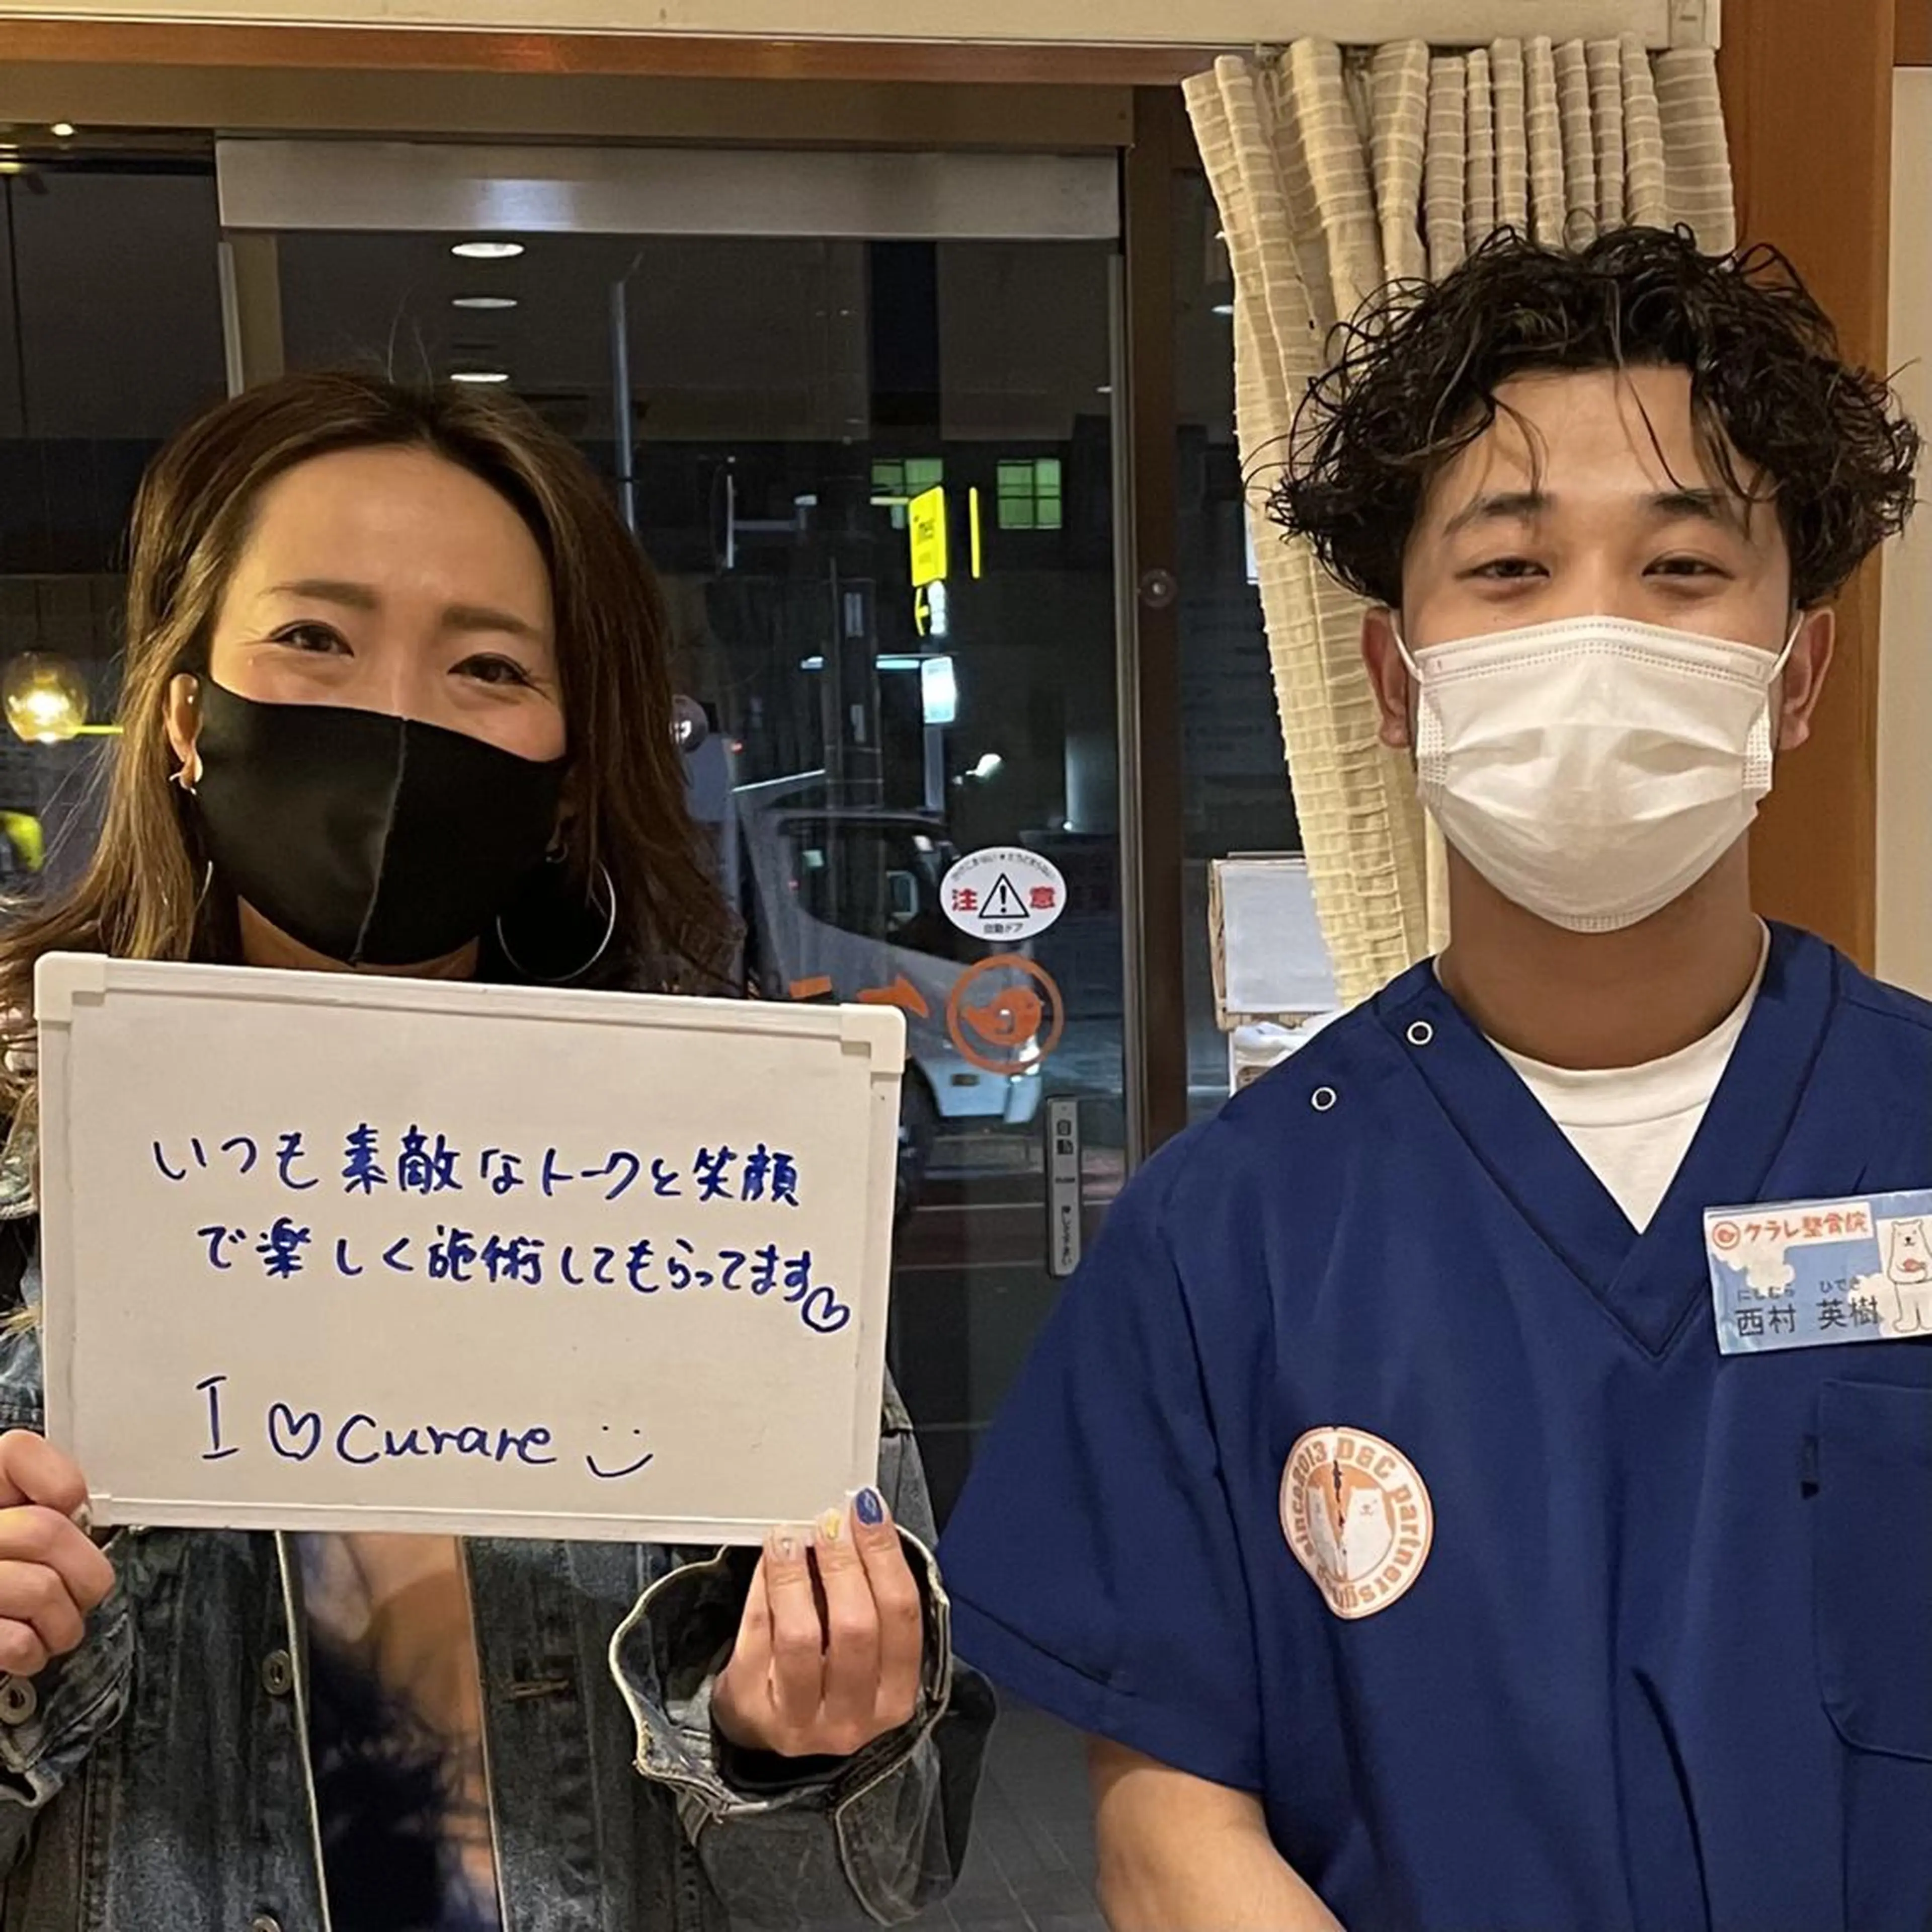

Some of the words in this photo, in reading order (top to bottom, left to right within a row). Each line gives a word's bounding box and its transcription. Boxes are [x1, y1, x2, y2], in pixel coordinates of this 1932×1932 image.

[154, 1123, 798, 1206] いつも素敵なトークと笑顔
[1735, 1303, 1796, 1336] 西村
[1816, 1295, 1883, 1330] 英樹
[197, 1376, 238, 1459] I
[337, 1415, 556, 1464] Curare
